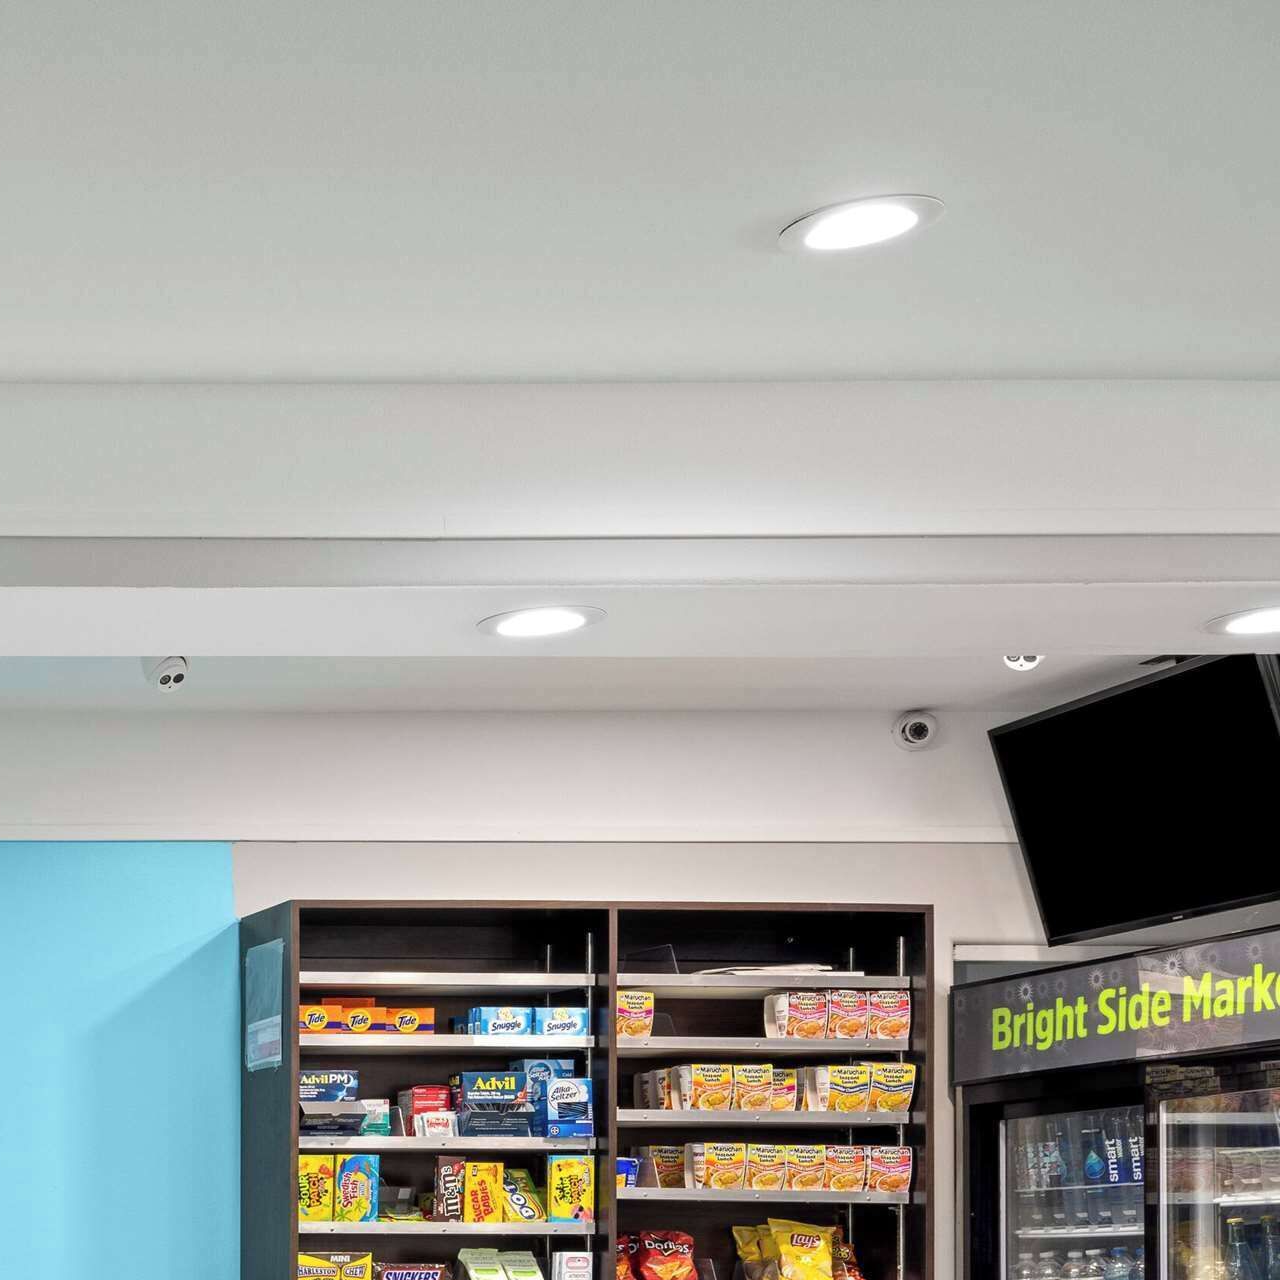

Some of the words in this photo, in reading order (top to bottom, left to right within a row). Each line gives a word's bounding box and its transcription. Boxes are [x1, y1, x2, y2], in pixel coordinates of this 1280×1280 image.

[307, 1013, 325, 1025] Tide
[351, 1015, 369, 1027] Tide
[398, 1015, 416, 1027] Tide
[992, 997, 1088, 1050] Bright
[1097, 983, 1171, 1036] Side
[491, 1020, 522, 1031] Snuggle
[547, 1020, 578, 1031] Snuggle
[300, 1074, 328, 1084] Advil
[329, 1074, 348, 1084] PM
[473, 1077, 516, 1090] Advil
[551, 1092, 577, 1102] Seltzer
[553, 1086, 573, 1094] Alka-
[1105, 1139, 1118, 1182] smart
[1129, 1136, 1142, 1180] smart
[300, 1174, 310, 1207] SOUR
[309, 1173, 320, 1207] PATCH
[342, 1172, 352, 1208] Swedish
[350, 1180, 359, 1200] Fish
[562, 1177, 571, 1203] SOUR
[570, 1175, 579, 1204] PATCH
[478, 1179, 494, 1216] BABIES
[470, 1190, 483, 1223] SUGAR
[644, 1240, 689, 1253] Doritos
[793, 1234, 820, 1248] Lay's
[299, 1266, 336, 1277] HARLESTON
[344, 1266, 364, 1276] CHEW
